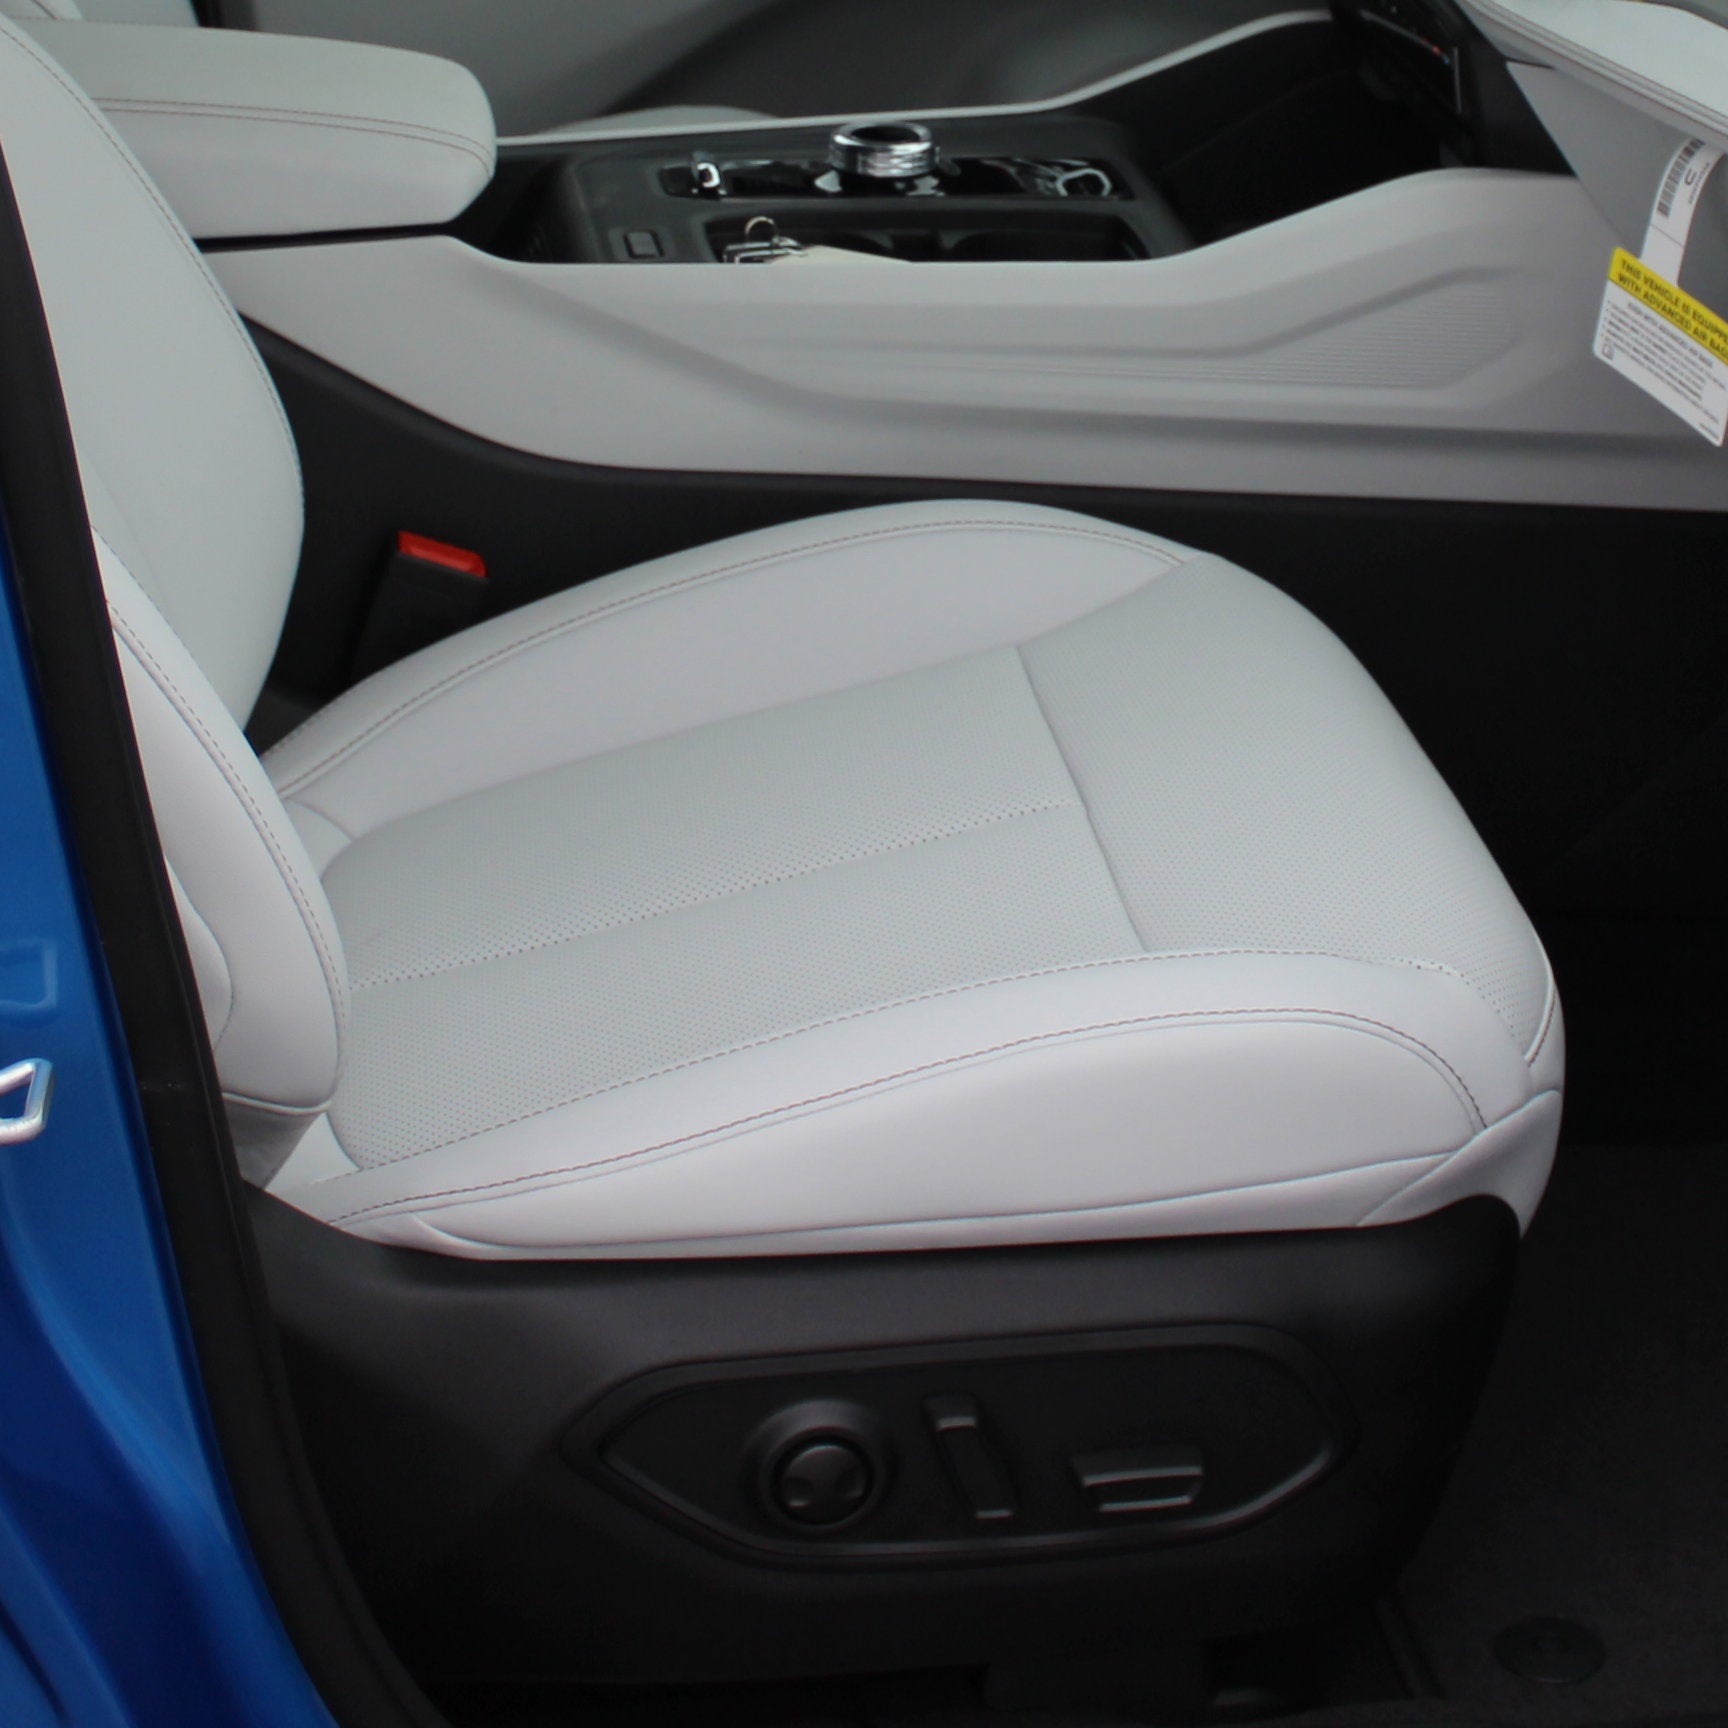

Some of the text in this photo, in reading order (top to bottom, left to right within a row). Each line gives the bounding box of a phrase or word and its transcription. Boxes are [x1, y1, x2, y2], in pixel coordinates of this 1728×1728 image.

[1618, 271, 1642, 295] WITH
[1643, 289, 1693, 335] ADVANCED
[1692, 324, 1709, 343] AIR
[1622, 259, 1642, 281] THIS
[1643, 271, 1680, 309] VEHICLE
[1682, 297, 1692, 315] IS
